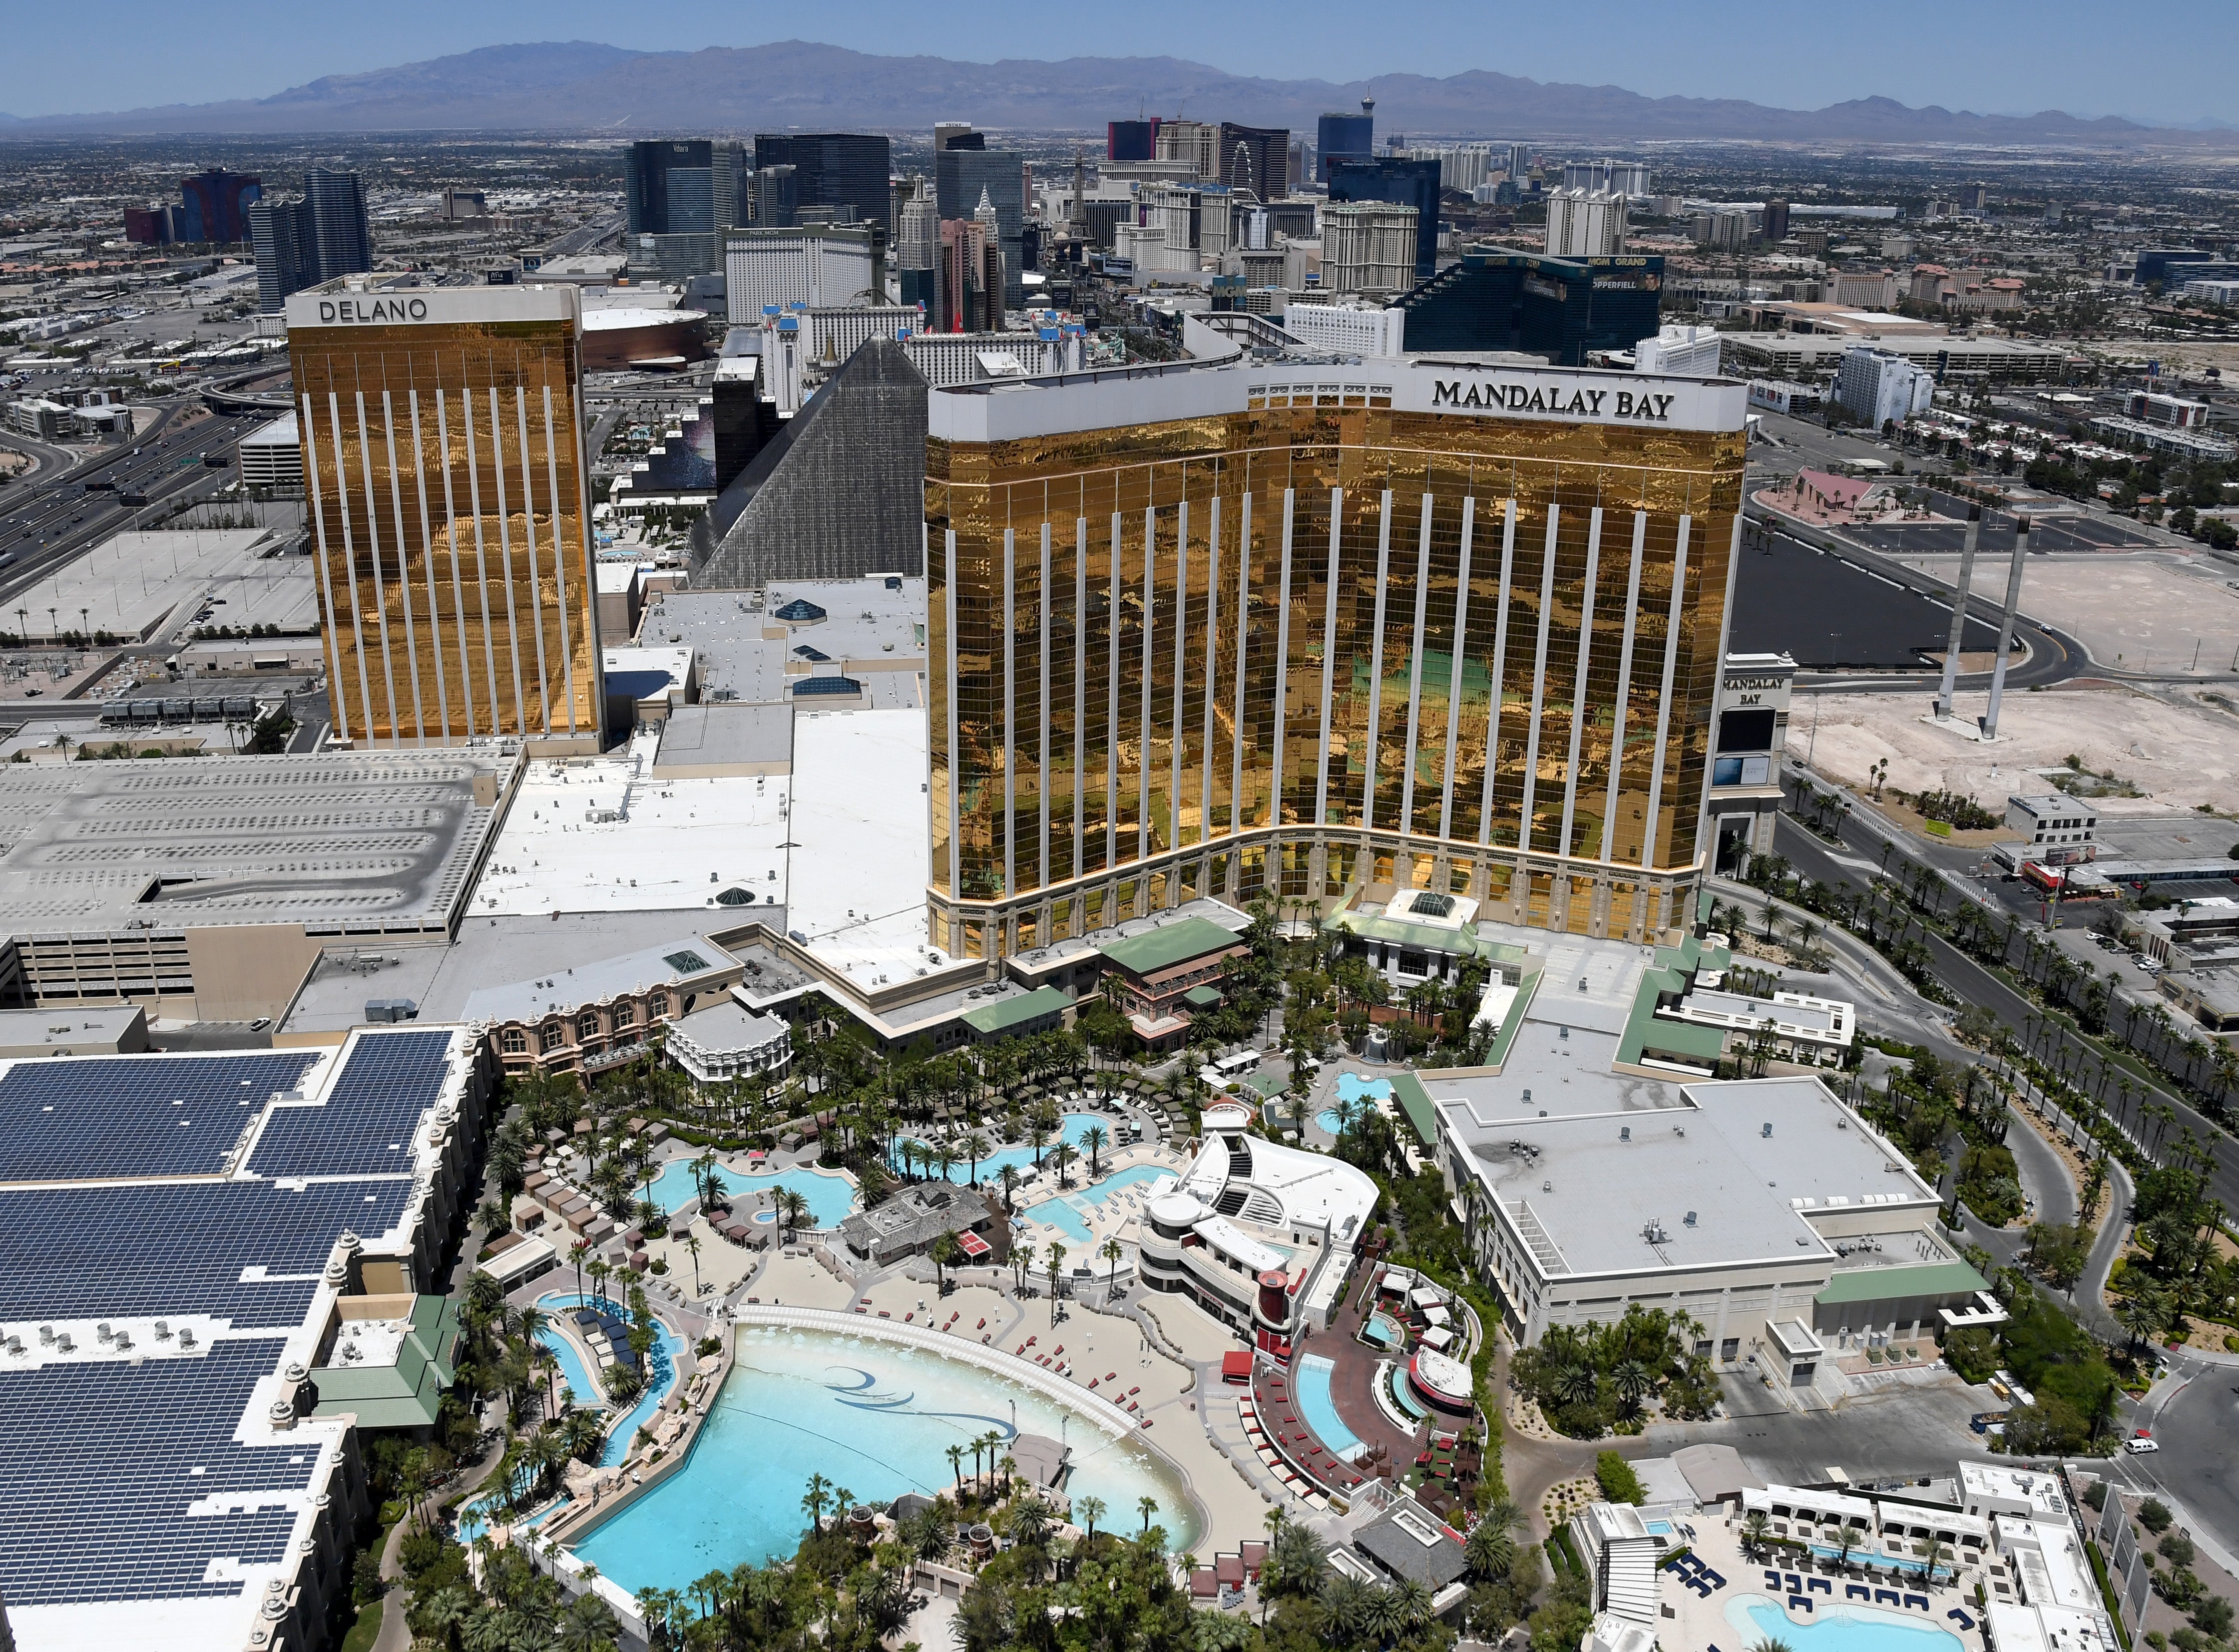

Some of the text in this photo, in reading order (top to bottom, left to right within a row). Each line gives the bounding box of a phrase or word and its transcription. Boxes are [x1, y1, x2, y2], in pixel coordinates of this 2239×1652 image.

[673, 144, 689, 153] Vdara
[1022, 224, 1035, 232] Aria
[1588, 257, 1647, 266] MGM GRAND
[1212, 285, 1247, 298] MGM
[319, 299, 427, 323] DELANO
[1432, 380, 1674, 421] MANDALAY BAY
[1722, 678, 1784, 691] MANDALAY
[1740, 694, 1761, 705] BAY
